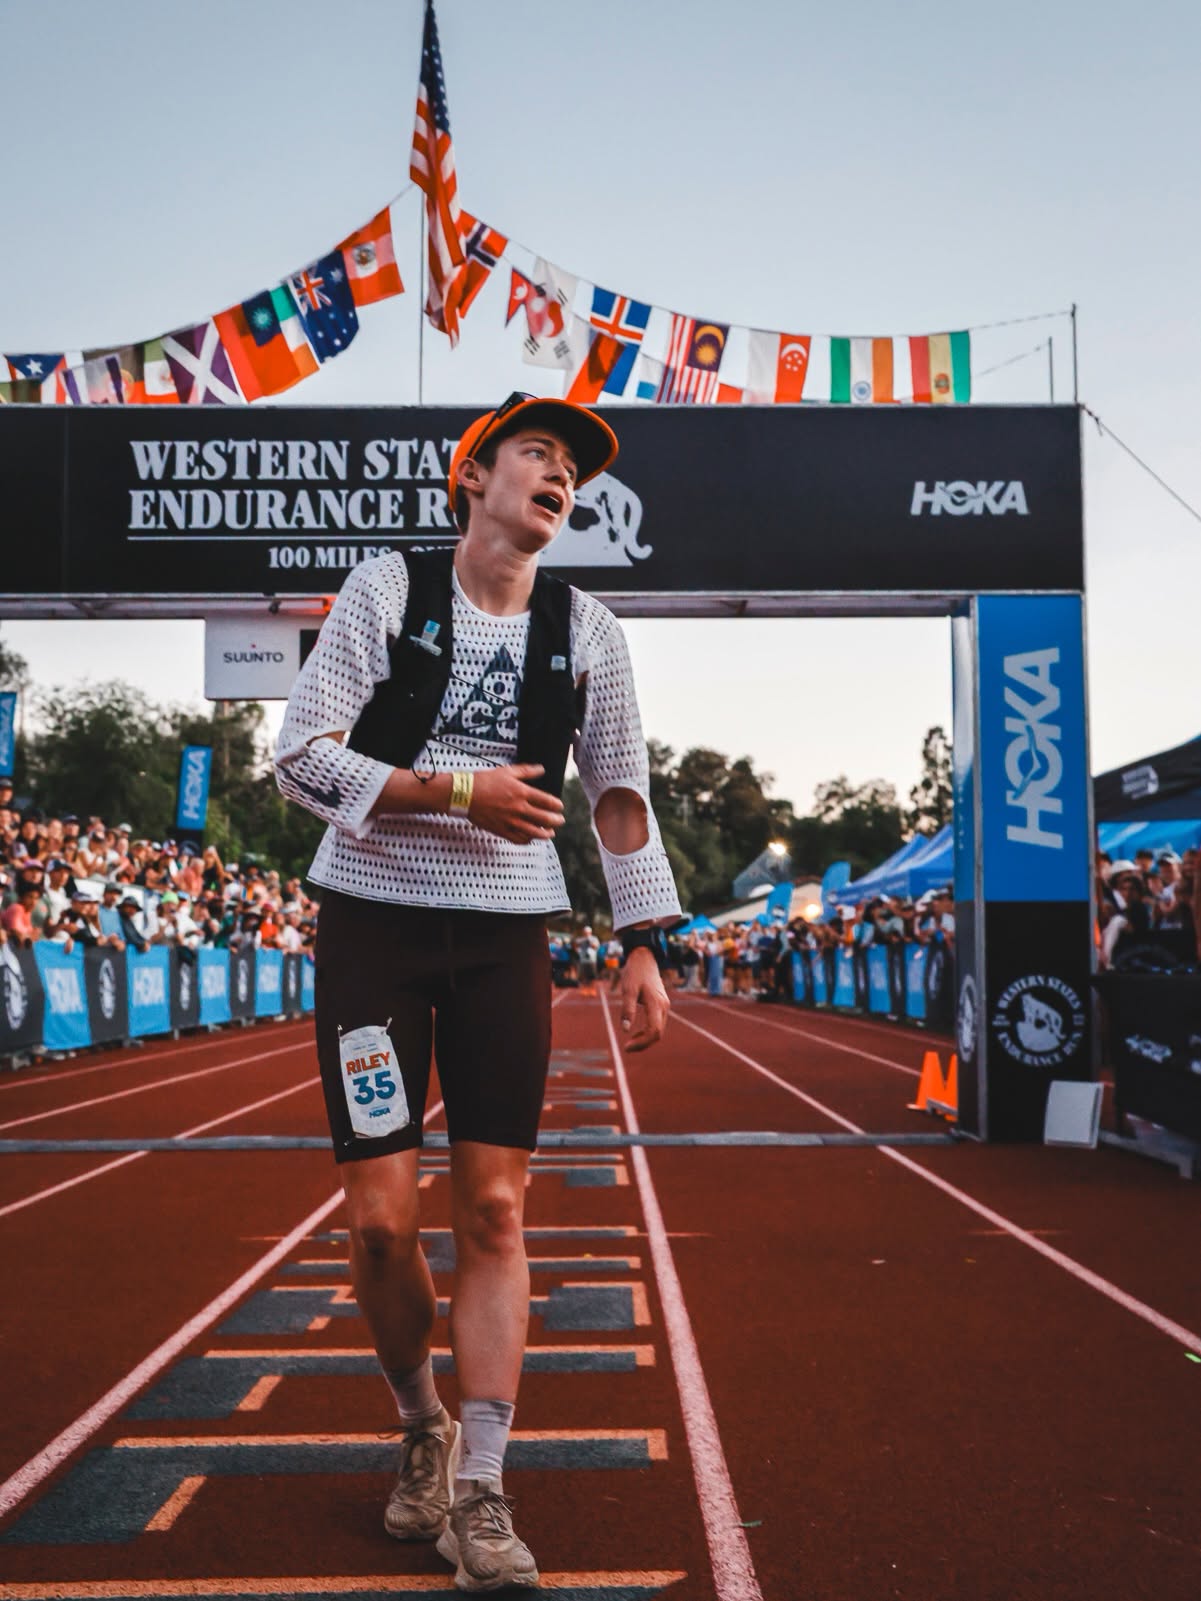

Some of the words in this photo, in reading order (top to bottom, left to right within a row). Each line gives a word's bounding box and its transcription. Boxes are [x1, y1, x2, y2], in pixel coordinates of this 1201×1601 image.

[129, 438, 350, 480] WESTERN
[128, 488, 404, 530] ENDURANCE
[910, 480, 1030, 516] HOKA
[269, 546, 311, 568] 100
[223, 651, 284, 663] SUUNTO
[1003, 647, 1064, 849] HOKA
[182, 750, 206, 819] HOKA
[346, 1052, 390, 1075] RILEY
[353, 1071, 396, 1105] 35
[368, 1107, 391, 1118] HOKA
